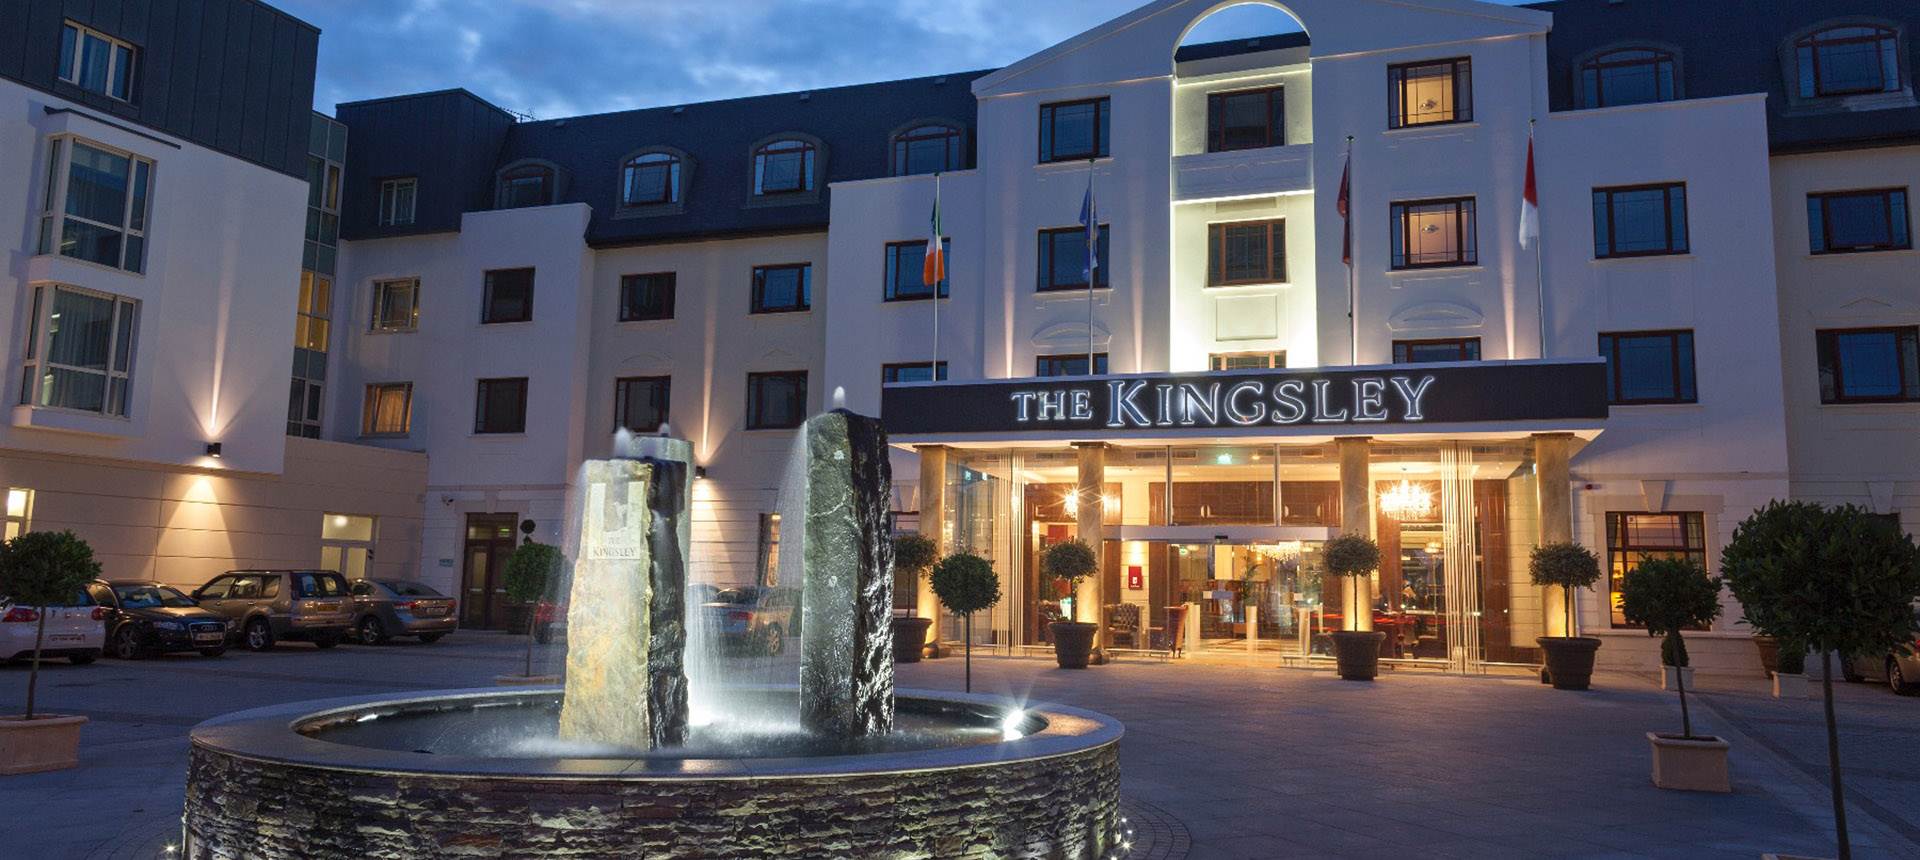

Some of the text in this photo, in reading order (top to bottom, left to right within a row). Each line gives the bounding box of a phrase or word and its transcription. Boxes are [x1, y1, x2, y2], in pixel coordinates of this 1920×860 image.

[1011, 376, 1434, 427] THE KINGSLEY
[593, 547, 635, 556] KINGSLEY
